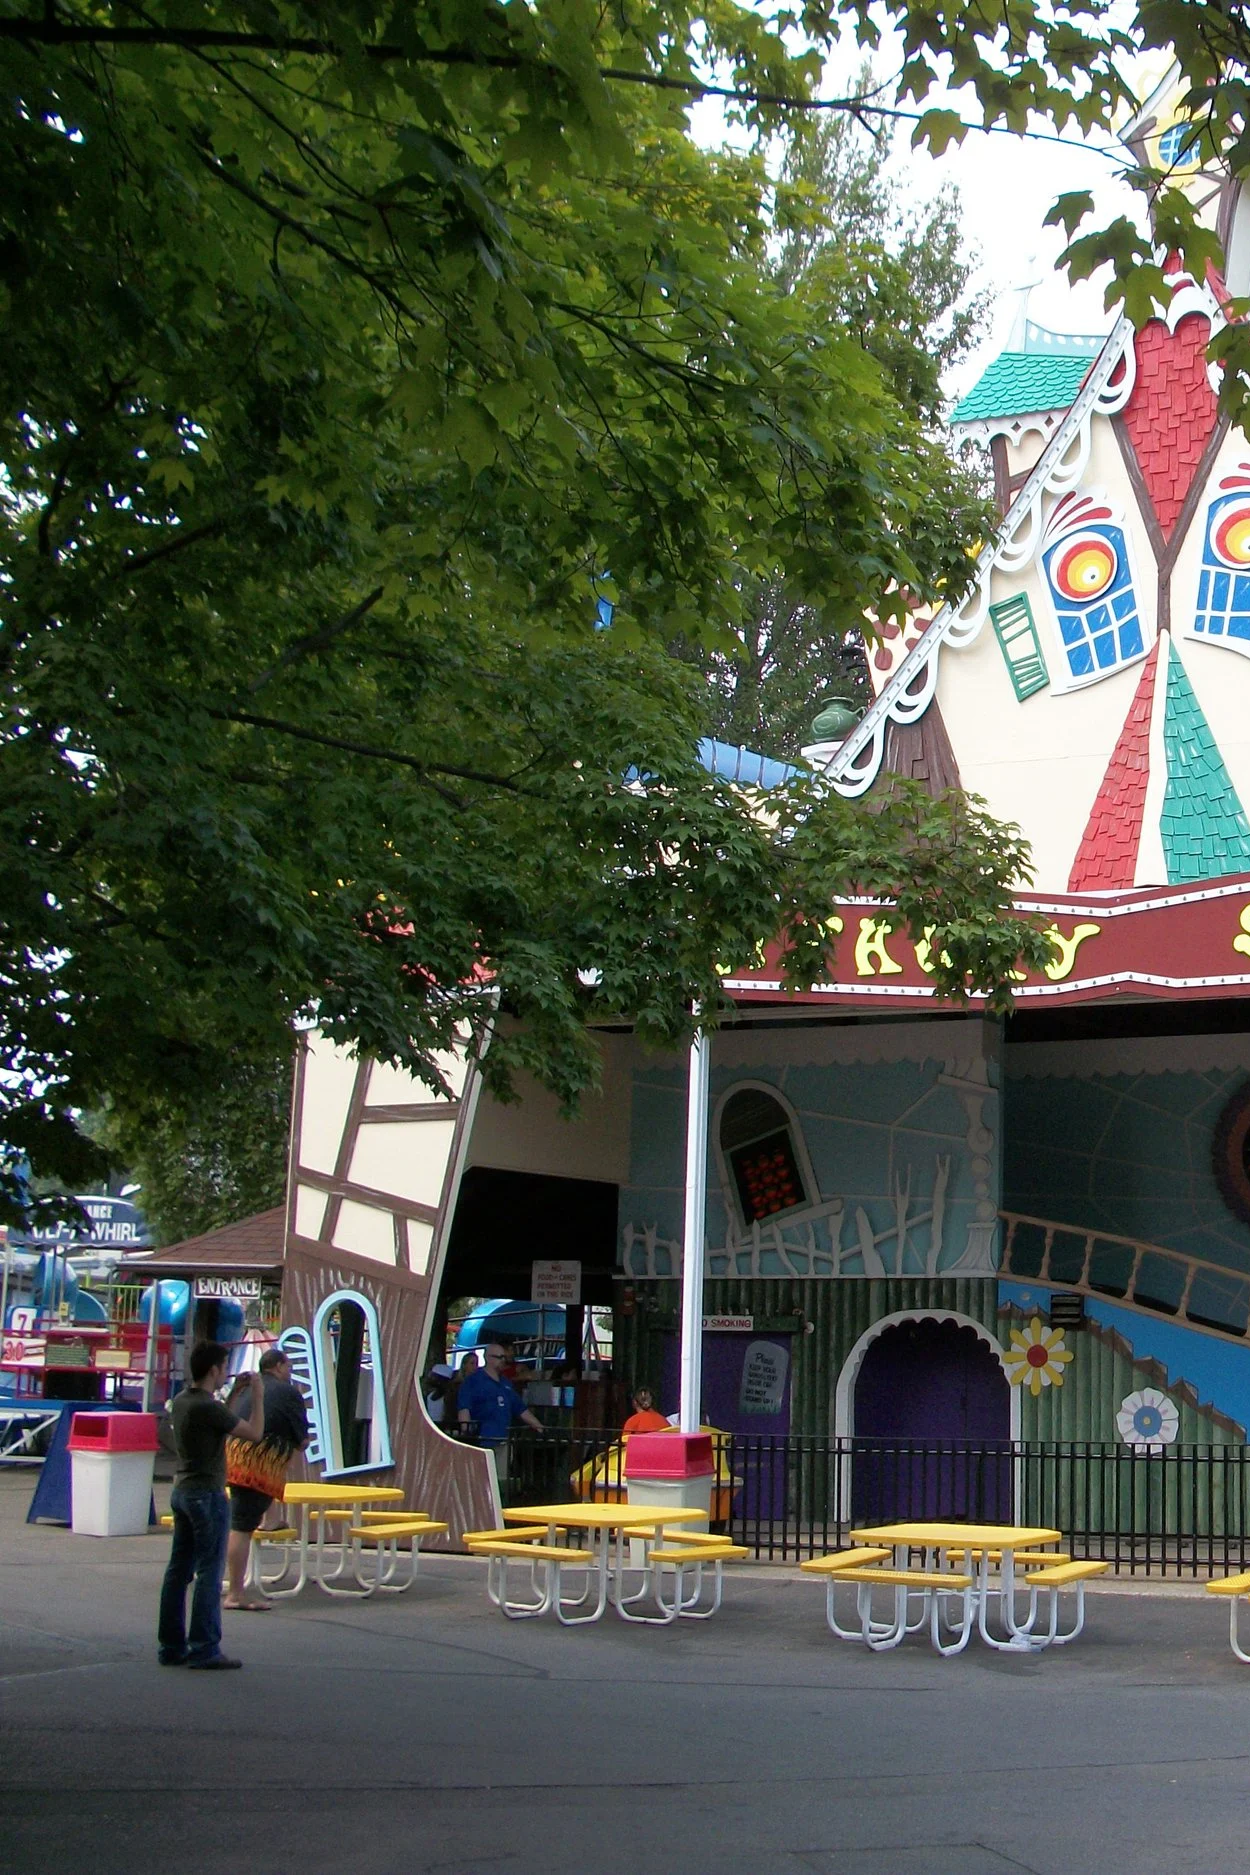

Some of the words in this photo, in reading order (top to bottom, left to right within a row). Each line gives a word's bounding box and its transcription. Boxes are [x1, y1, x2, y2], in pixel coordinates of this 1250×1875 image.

[197, 1277, 260, 1297] ENTRANCE
[18, 1314, 28, 1332] 7
[711, 1319, 752, 1328] SMOKING
